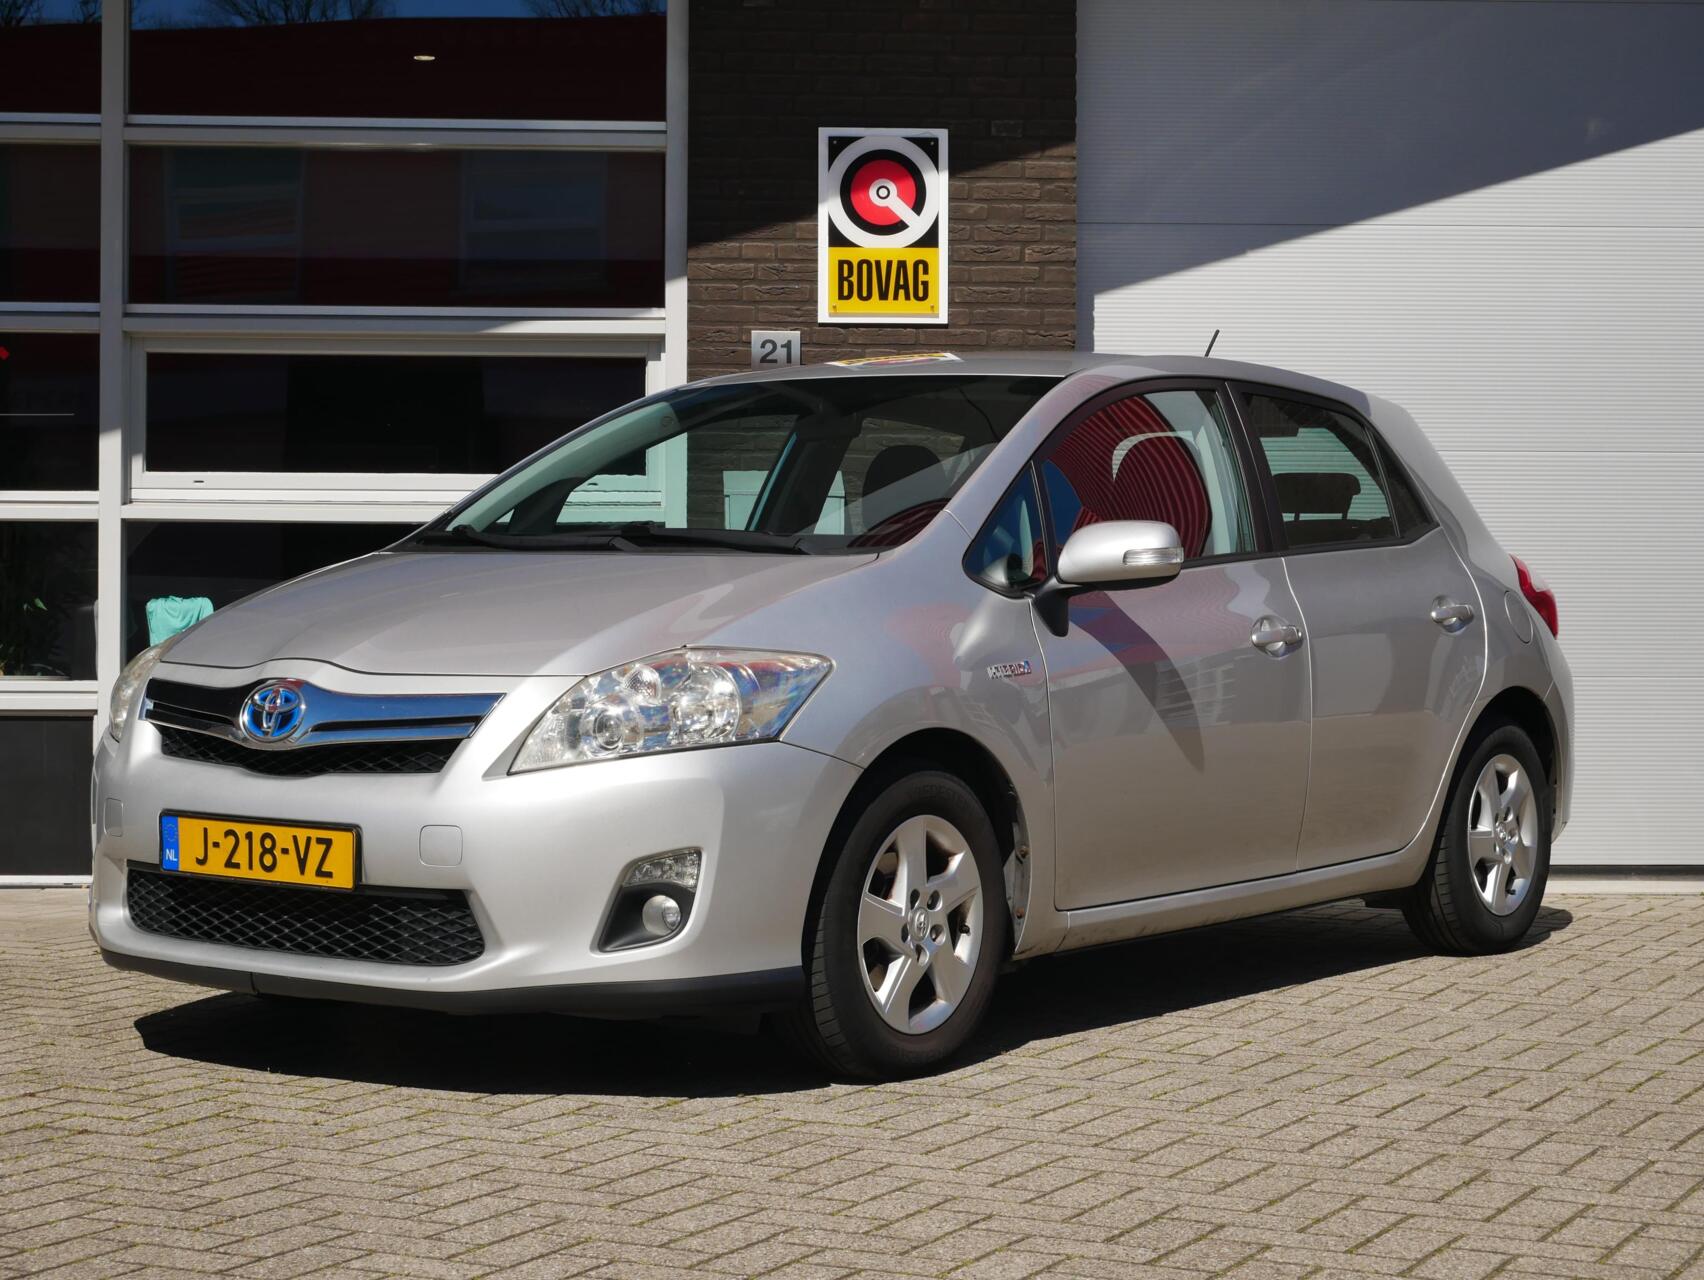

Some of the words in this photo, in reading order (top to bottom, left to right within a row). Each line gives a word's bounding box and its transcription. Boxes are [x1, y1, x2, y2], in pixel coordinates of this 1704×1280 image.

[837, 259, 929, 302] BOVAG
[759, 338, 793, 365] 21
[165, 848, 178, 862] NL
[195, 826, 334, 879] J-218-VZ
